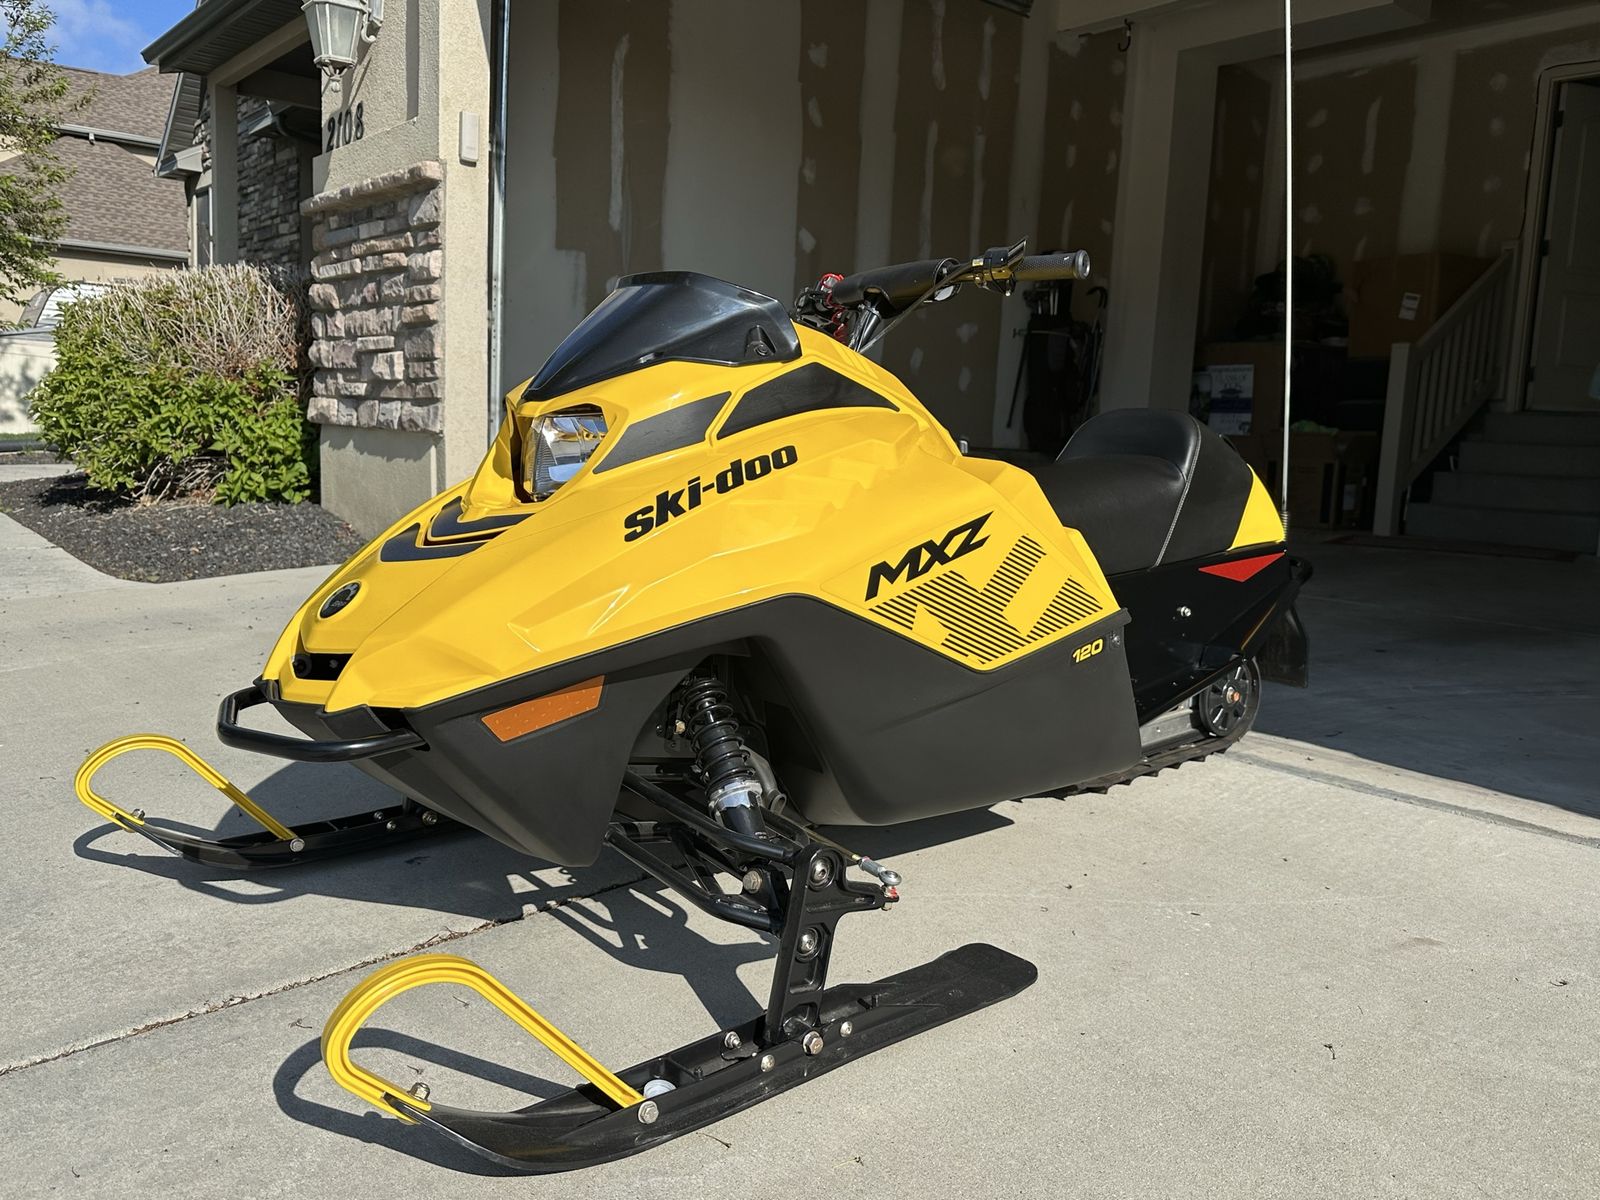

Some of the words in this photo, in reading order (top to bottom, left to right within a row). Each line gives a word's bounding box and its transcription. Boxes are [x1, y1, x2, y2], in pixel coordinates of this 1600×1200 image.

[326, 101, 364, 152] 2108
[624, 445, 798, 542] ski-doo
[865, 511, 994, 602] MXZ
[1072, 637, 1104, 663] 120
